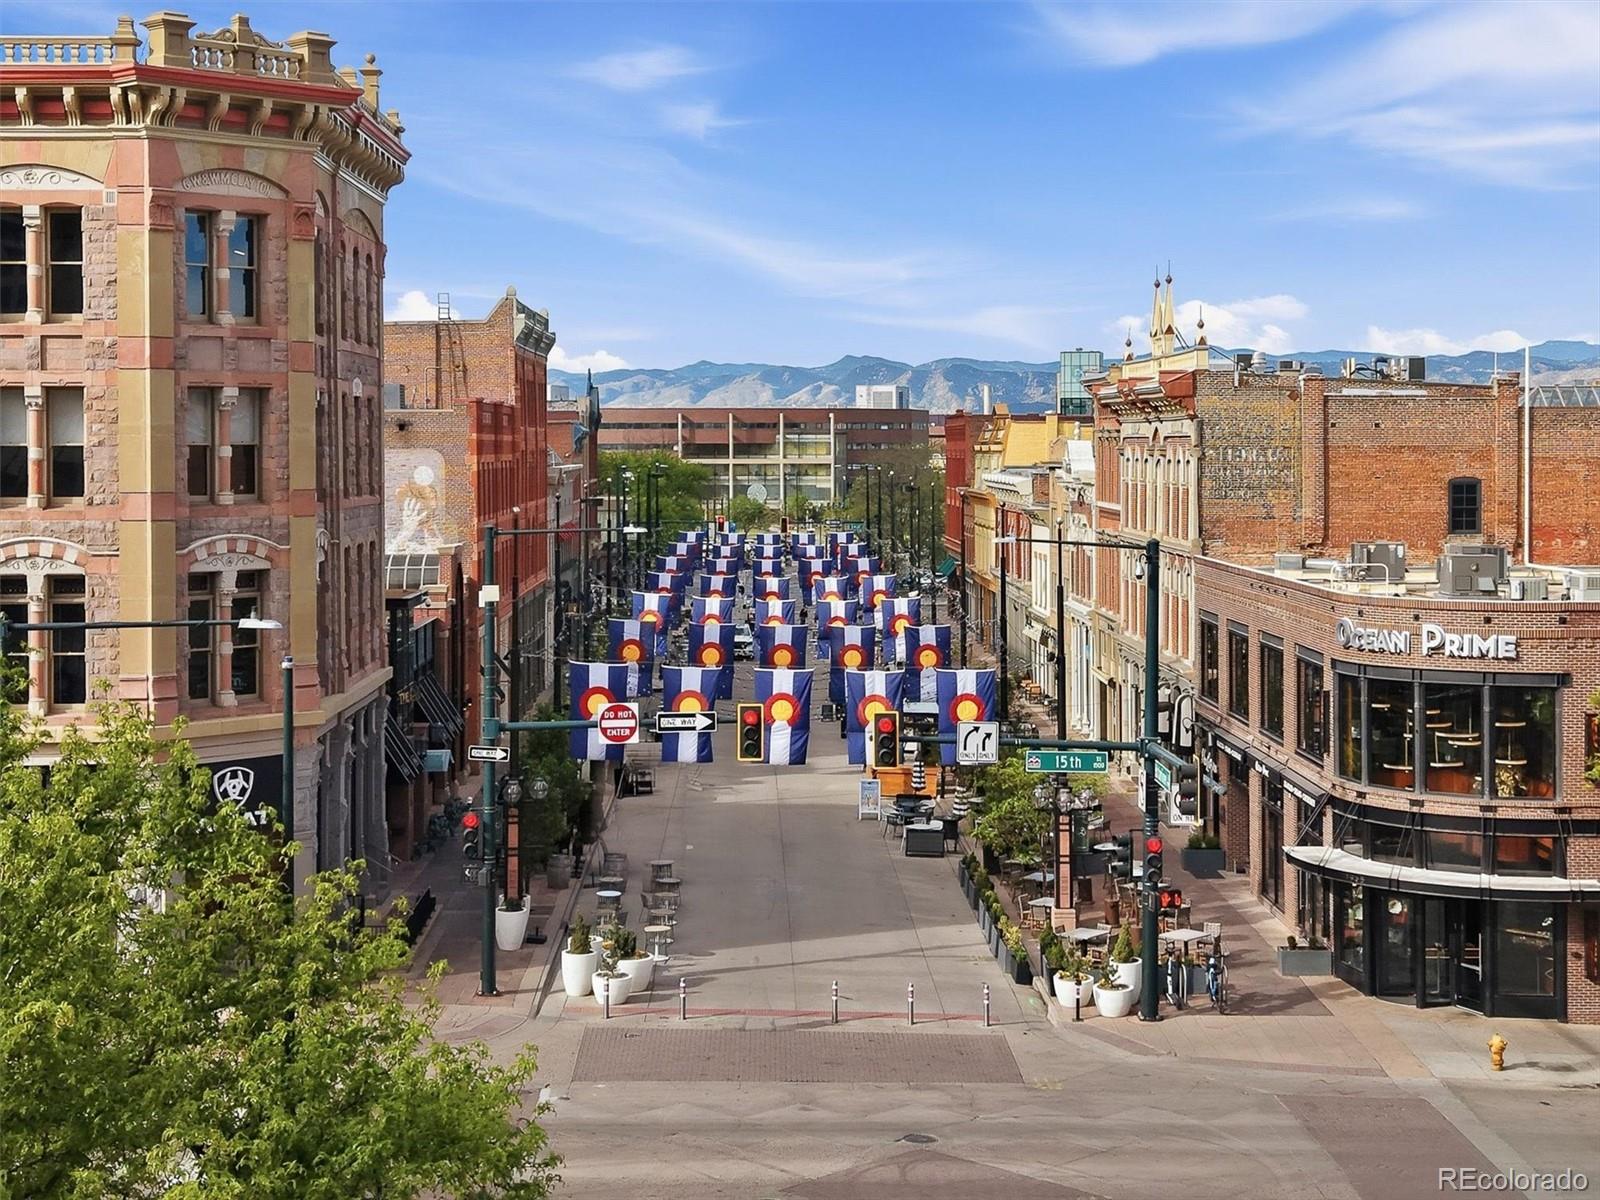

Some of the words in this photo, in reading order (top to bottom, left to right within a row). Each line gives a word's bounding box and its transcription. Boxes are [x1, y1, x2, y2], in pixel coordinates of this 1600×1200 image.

[231, 173, 272, 196] CLAYTON
[1336, 617, 1410, 654] OCEAN
[1421, 623, 1518, 659] PRIME
[604, 711, 615, 719] DO
[1055, 755, 1082, 769] 15th
